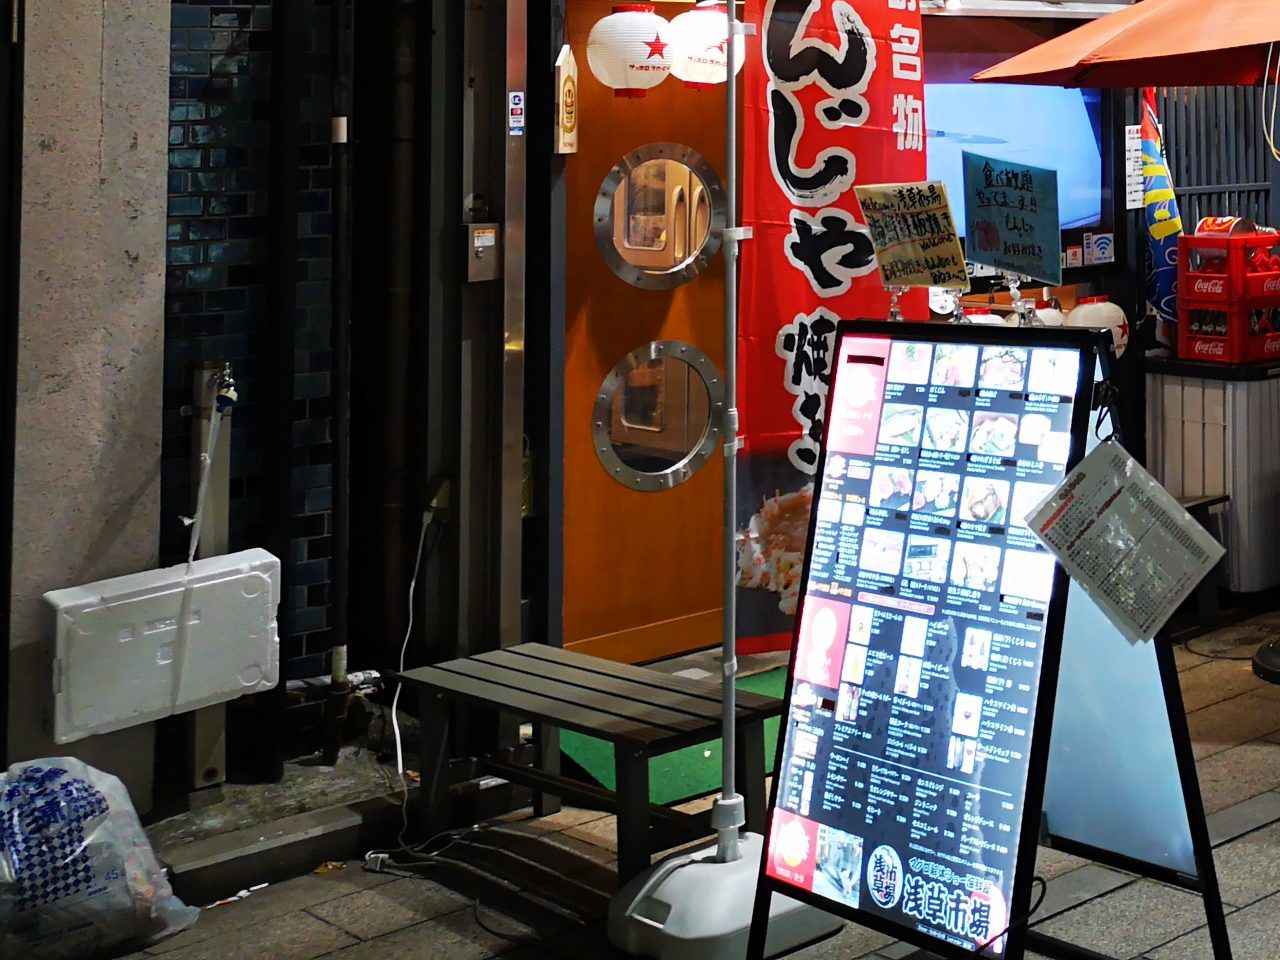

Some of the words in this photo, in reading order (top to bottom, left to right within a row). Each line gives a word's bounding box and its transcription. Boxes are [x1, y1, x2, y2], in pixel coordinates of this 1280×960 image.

[981, 160, 1034, 192] 食べ放題
[1195, 278, 1223, 293] Coca-Cola
[1195, 340, 1223, 355] Coca-Cola
[902, 874, 991, 940] 浅草市場
